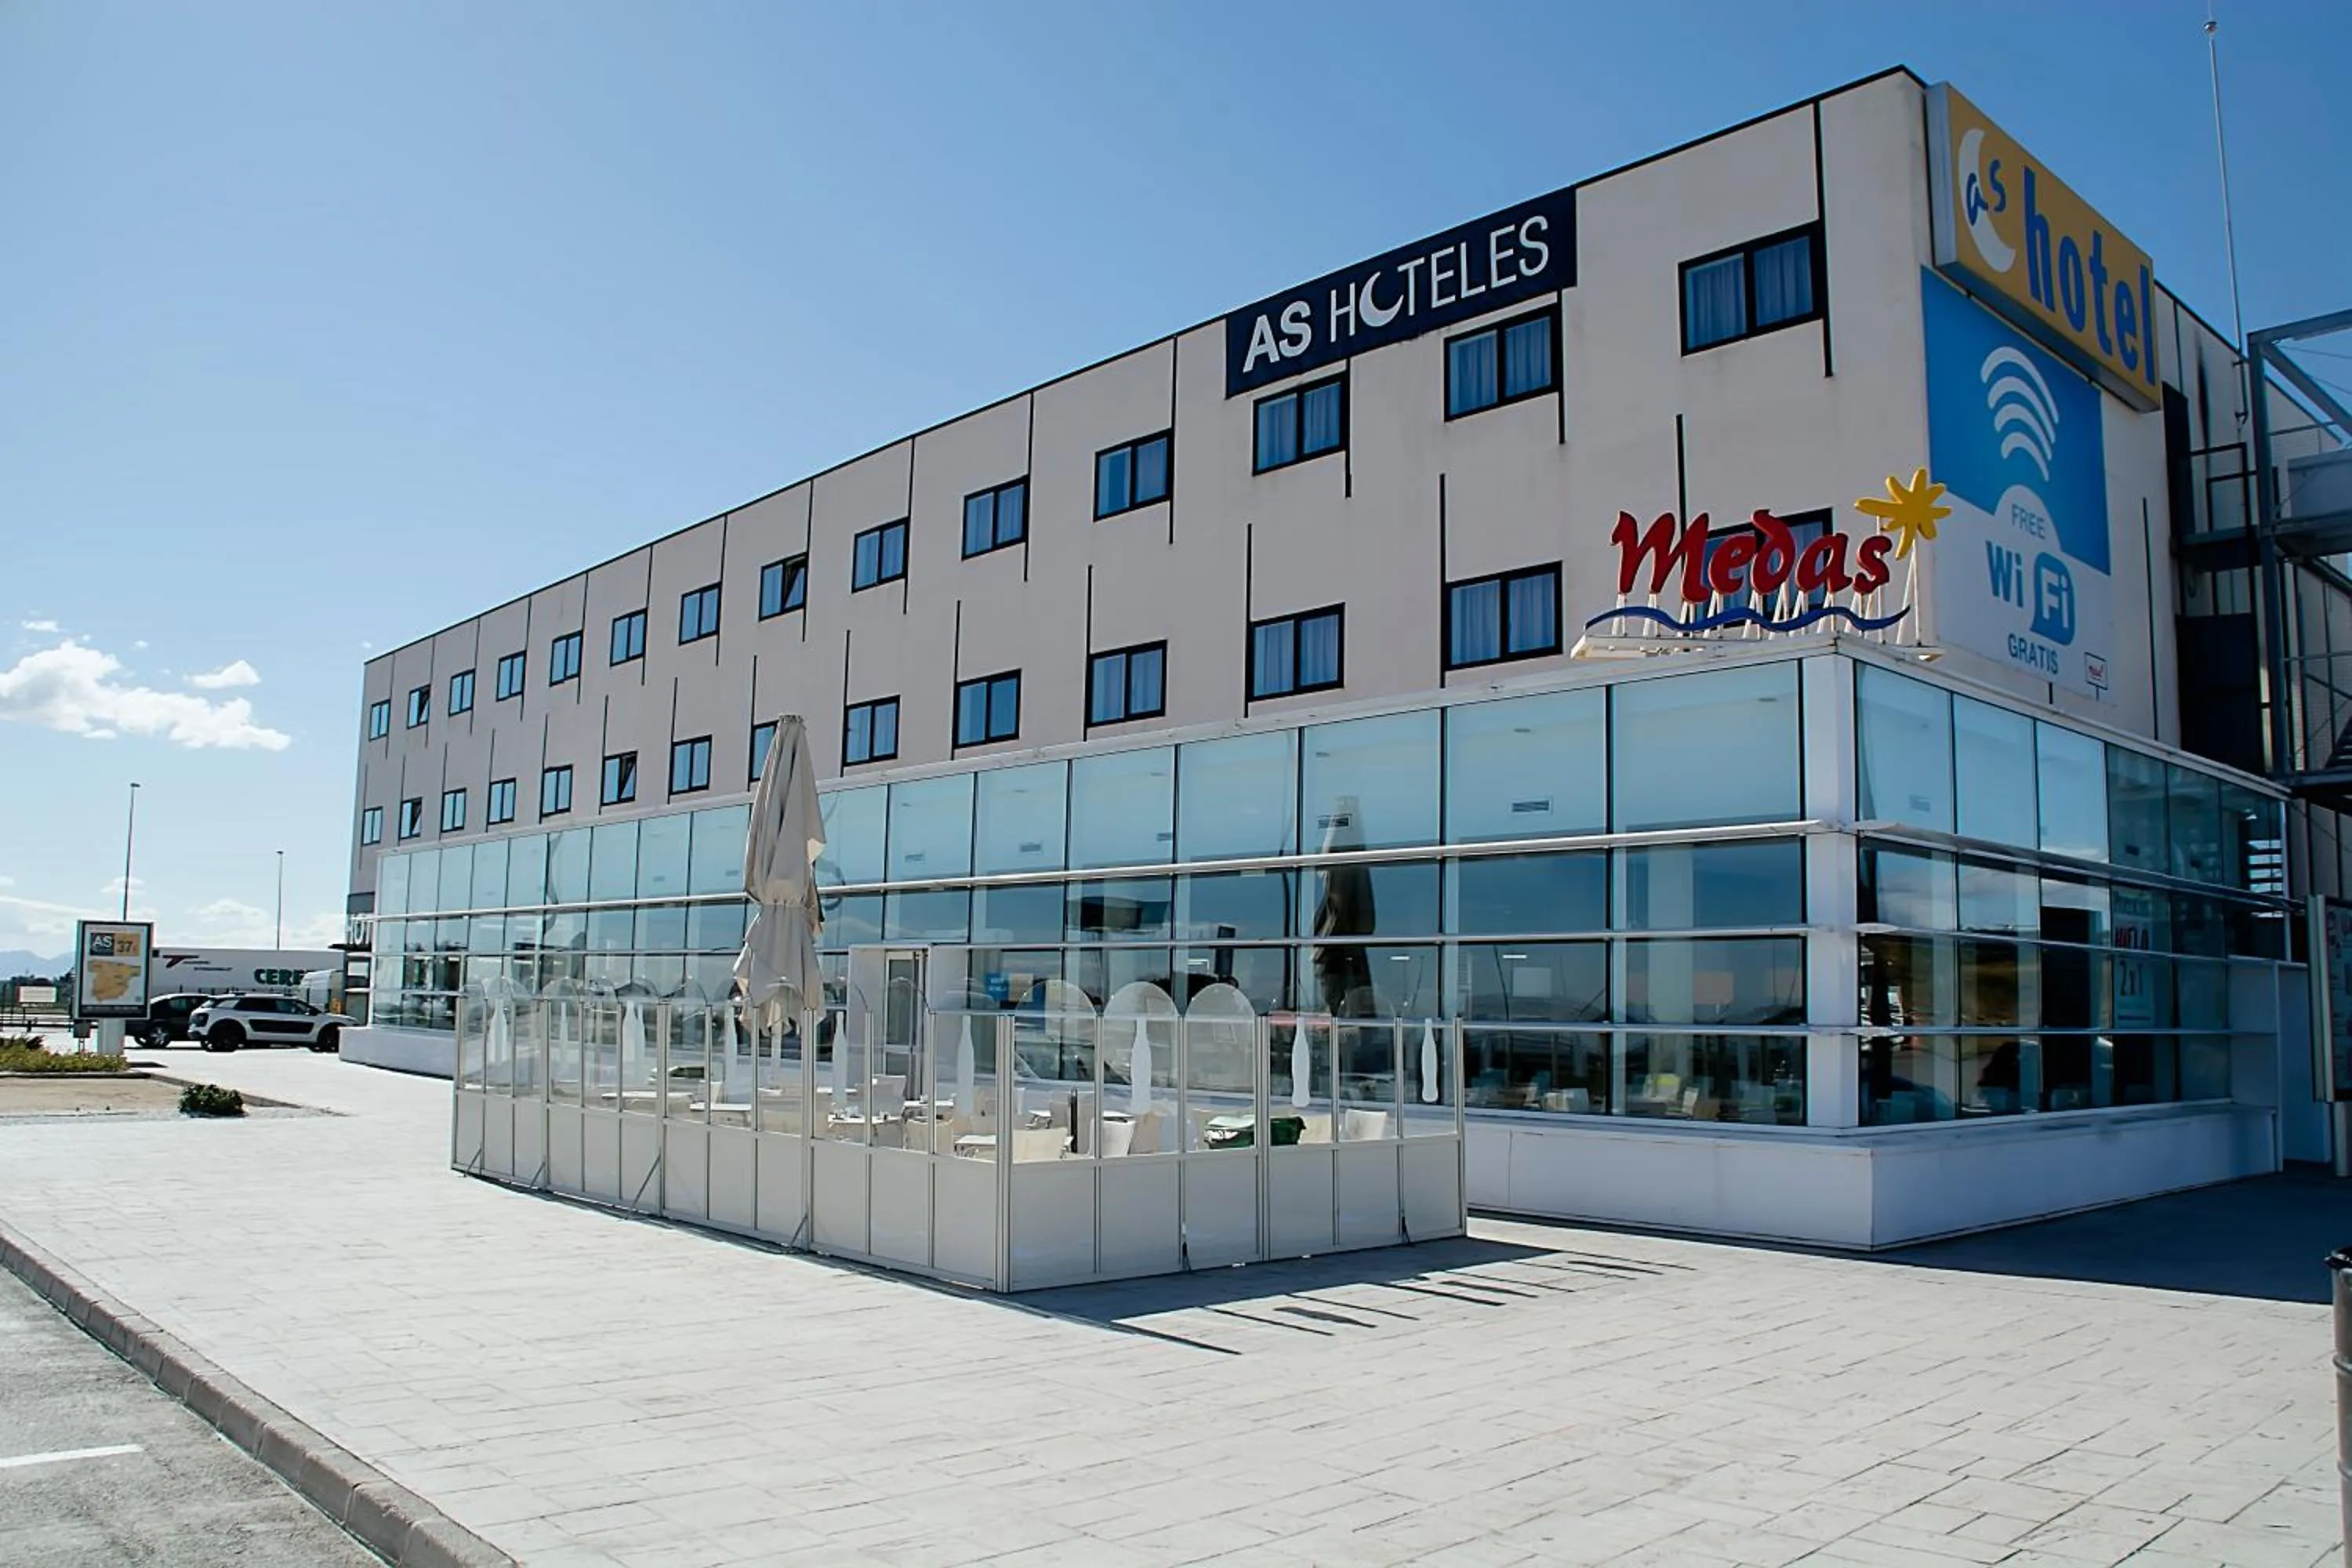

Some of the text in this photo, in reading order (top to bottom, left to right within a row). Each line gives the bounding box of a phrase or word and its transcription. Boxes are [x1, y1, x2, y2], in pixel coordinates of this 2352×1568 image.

[1242, 216, 1549, 372] AS HOTELES
[1965, 159, 2157, 387] as hotel
[1611, 508, 1893, 603] Medas
[2011, 503, 2046, 540] FREE
[2007, 633, 2059, 675] GRATIS
[93, 935, 113, 948] AS
